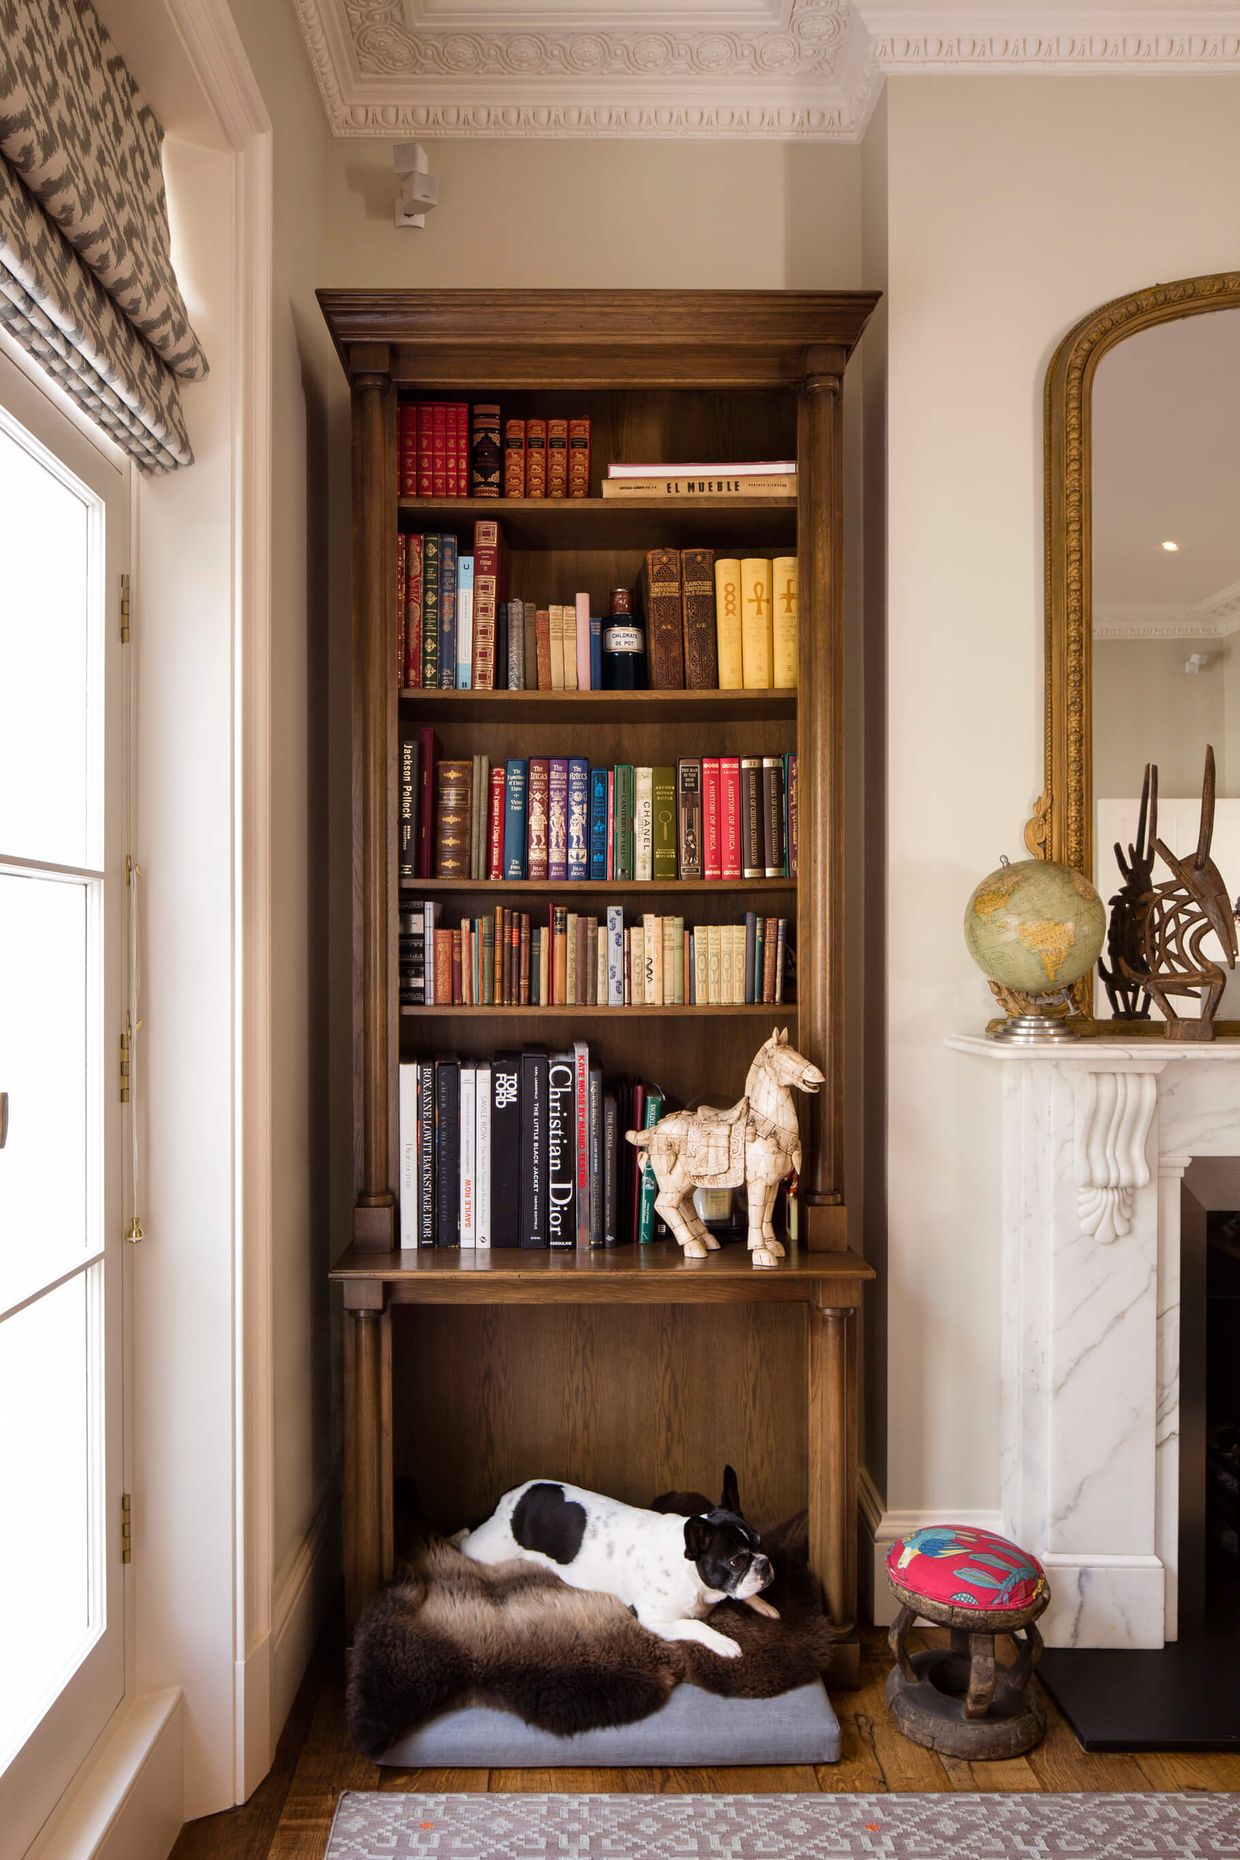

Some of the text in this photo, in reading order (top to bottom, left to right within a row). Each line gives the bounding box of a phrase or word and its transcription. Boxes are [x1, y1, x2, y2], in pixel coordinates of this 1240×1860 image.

[667, 483, 680, 493] EL
[688, 481, 740, 493] MUEBLE
[530, 772, 548, 780] Incas
[550, 771, 567, 780] Maya
[552, 764, 563, 772] The
[570, 772, 587, 780] Aztecs
[402, 744, 413, 818] Jackson Pollock
[643, 801, 651, 850] CHANEL
[709, 815, 716, 825] OF
[728, 815, 735, 825] OF
[750, 807, 758, 830] CHINESE
[751, 831, 759, 865] CIVILISATION
[495, 1073, 507, 1109] FORD
[506, 1072, 518, 1103] TOM
[480, 1095, 488, 1122] SAVILE
[606, 1111, 614, 1125] THE
[480, 1123, 488, 1142] ROW
[577, 1055, 586, 1189] KATE MOSS BY MARIO TESTINO
[606, 1126, 614, 1148] HORSE
[422, 1068, 433, 1238] ROXANNE LOWIT BACKSTAGE DIOR
[549, 1064, 574, 1237] Christian Dior
[464, 1178, 472, 1199] ROW
[464, 1200, 472, 1229] SAVILE
